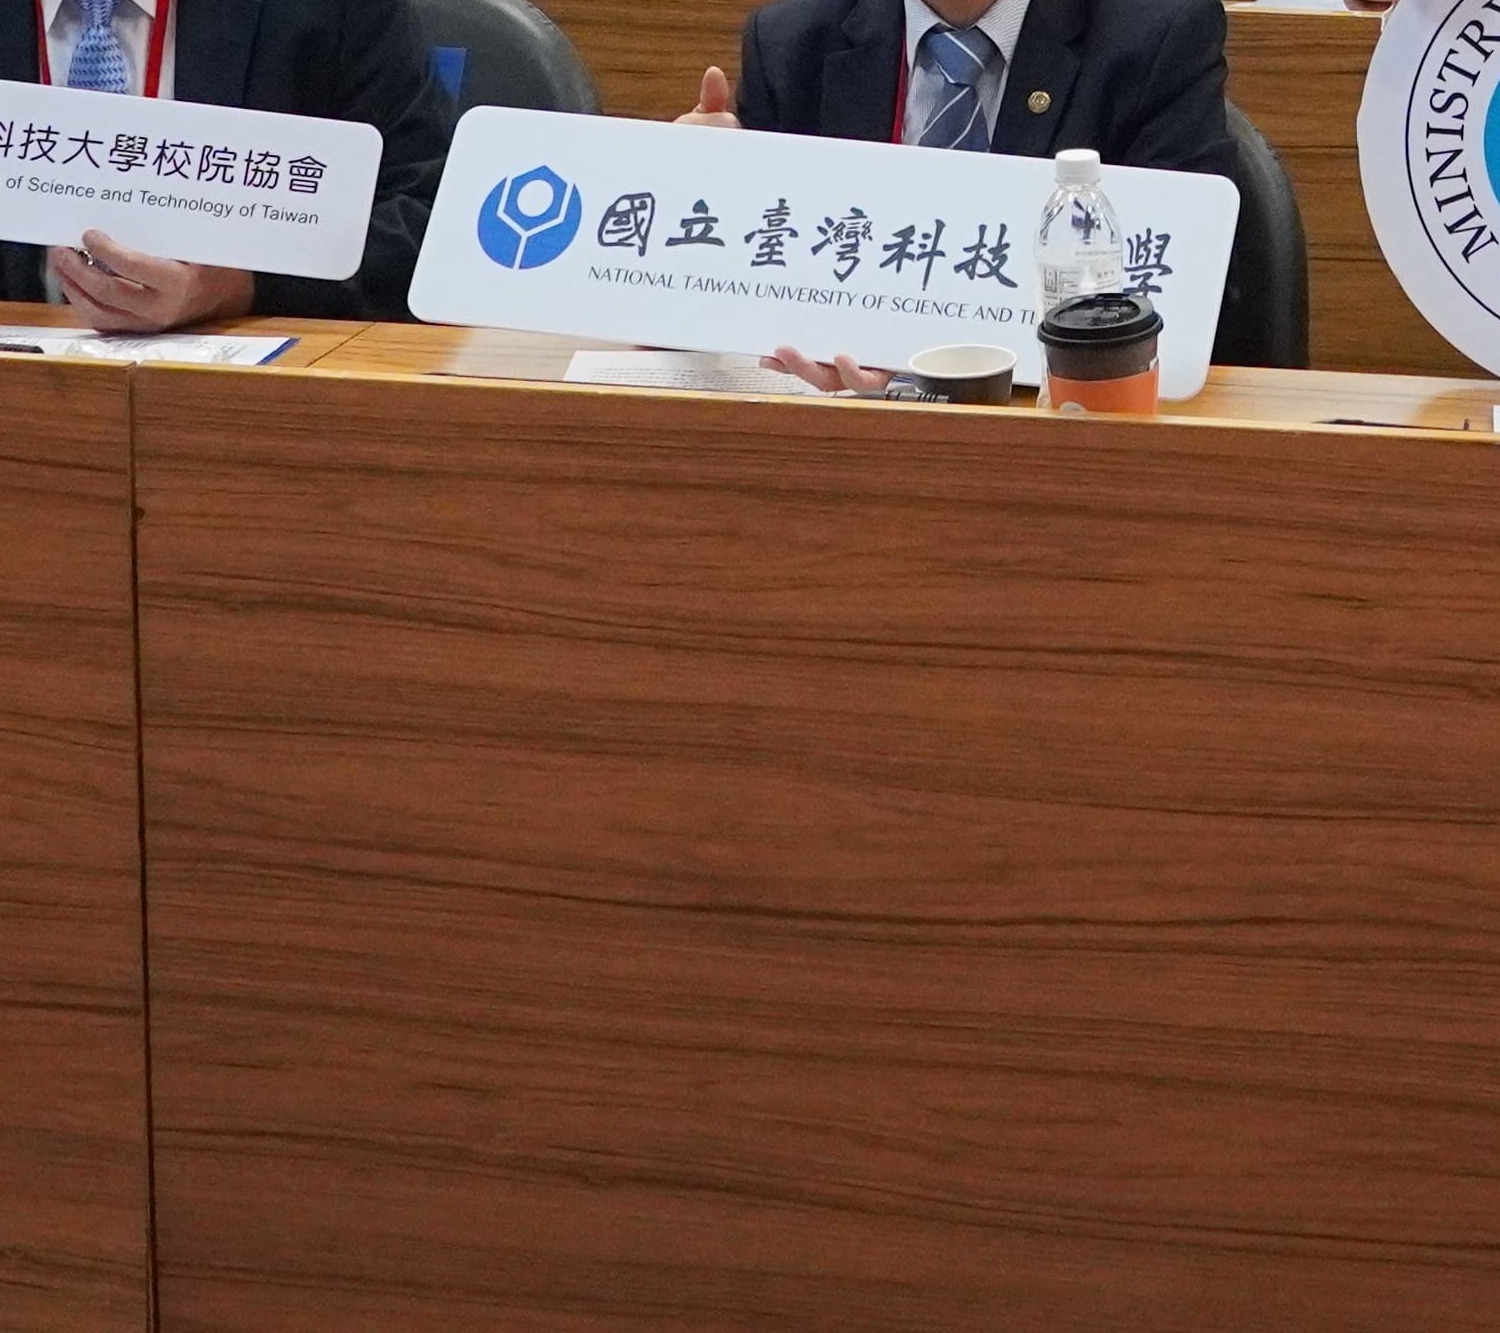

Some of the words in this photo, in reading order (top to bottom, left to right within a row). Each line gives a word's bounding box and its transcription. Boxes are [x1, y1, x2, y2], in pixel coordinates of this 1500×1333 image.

[6, 175, 24, 190] of
[28, 177, 95, 199] Science
[101, 187, 132, 204] and
[140, 190, 234, 218] Technology
[239, 203, 258, 218] of
[262, 205, 319, 226] Taiwan
[588, 266, 677, 290] NATIONAL
[683, 275, 751, 297] TAIWAN
[755, 283, 858, 308] UNIVERSITY
[862, 294, 885, 311] OF
[893, 296, 968, 319] SCIENCE
[975, 305, 1013, 324] AND
